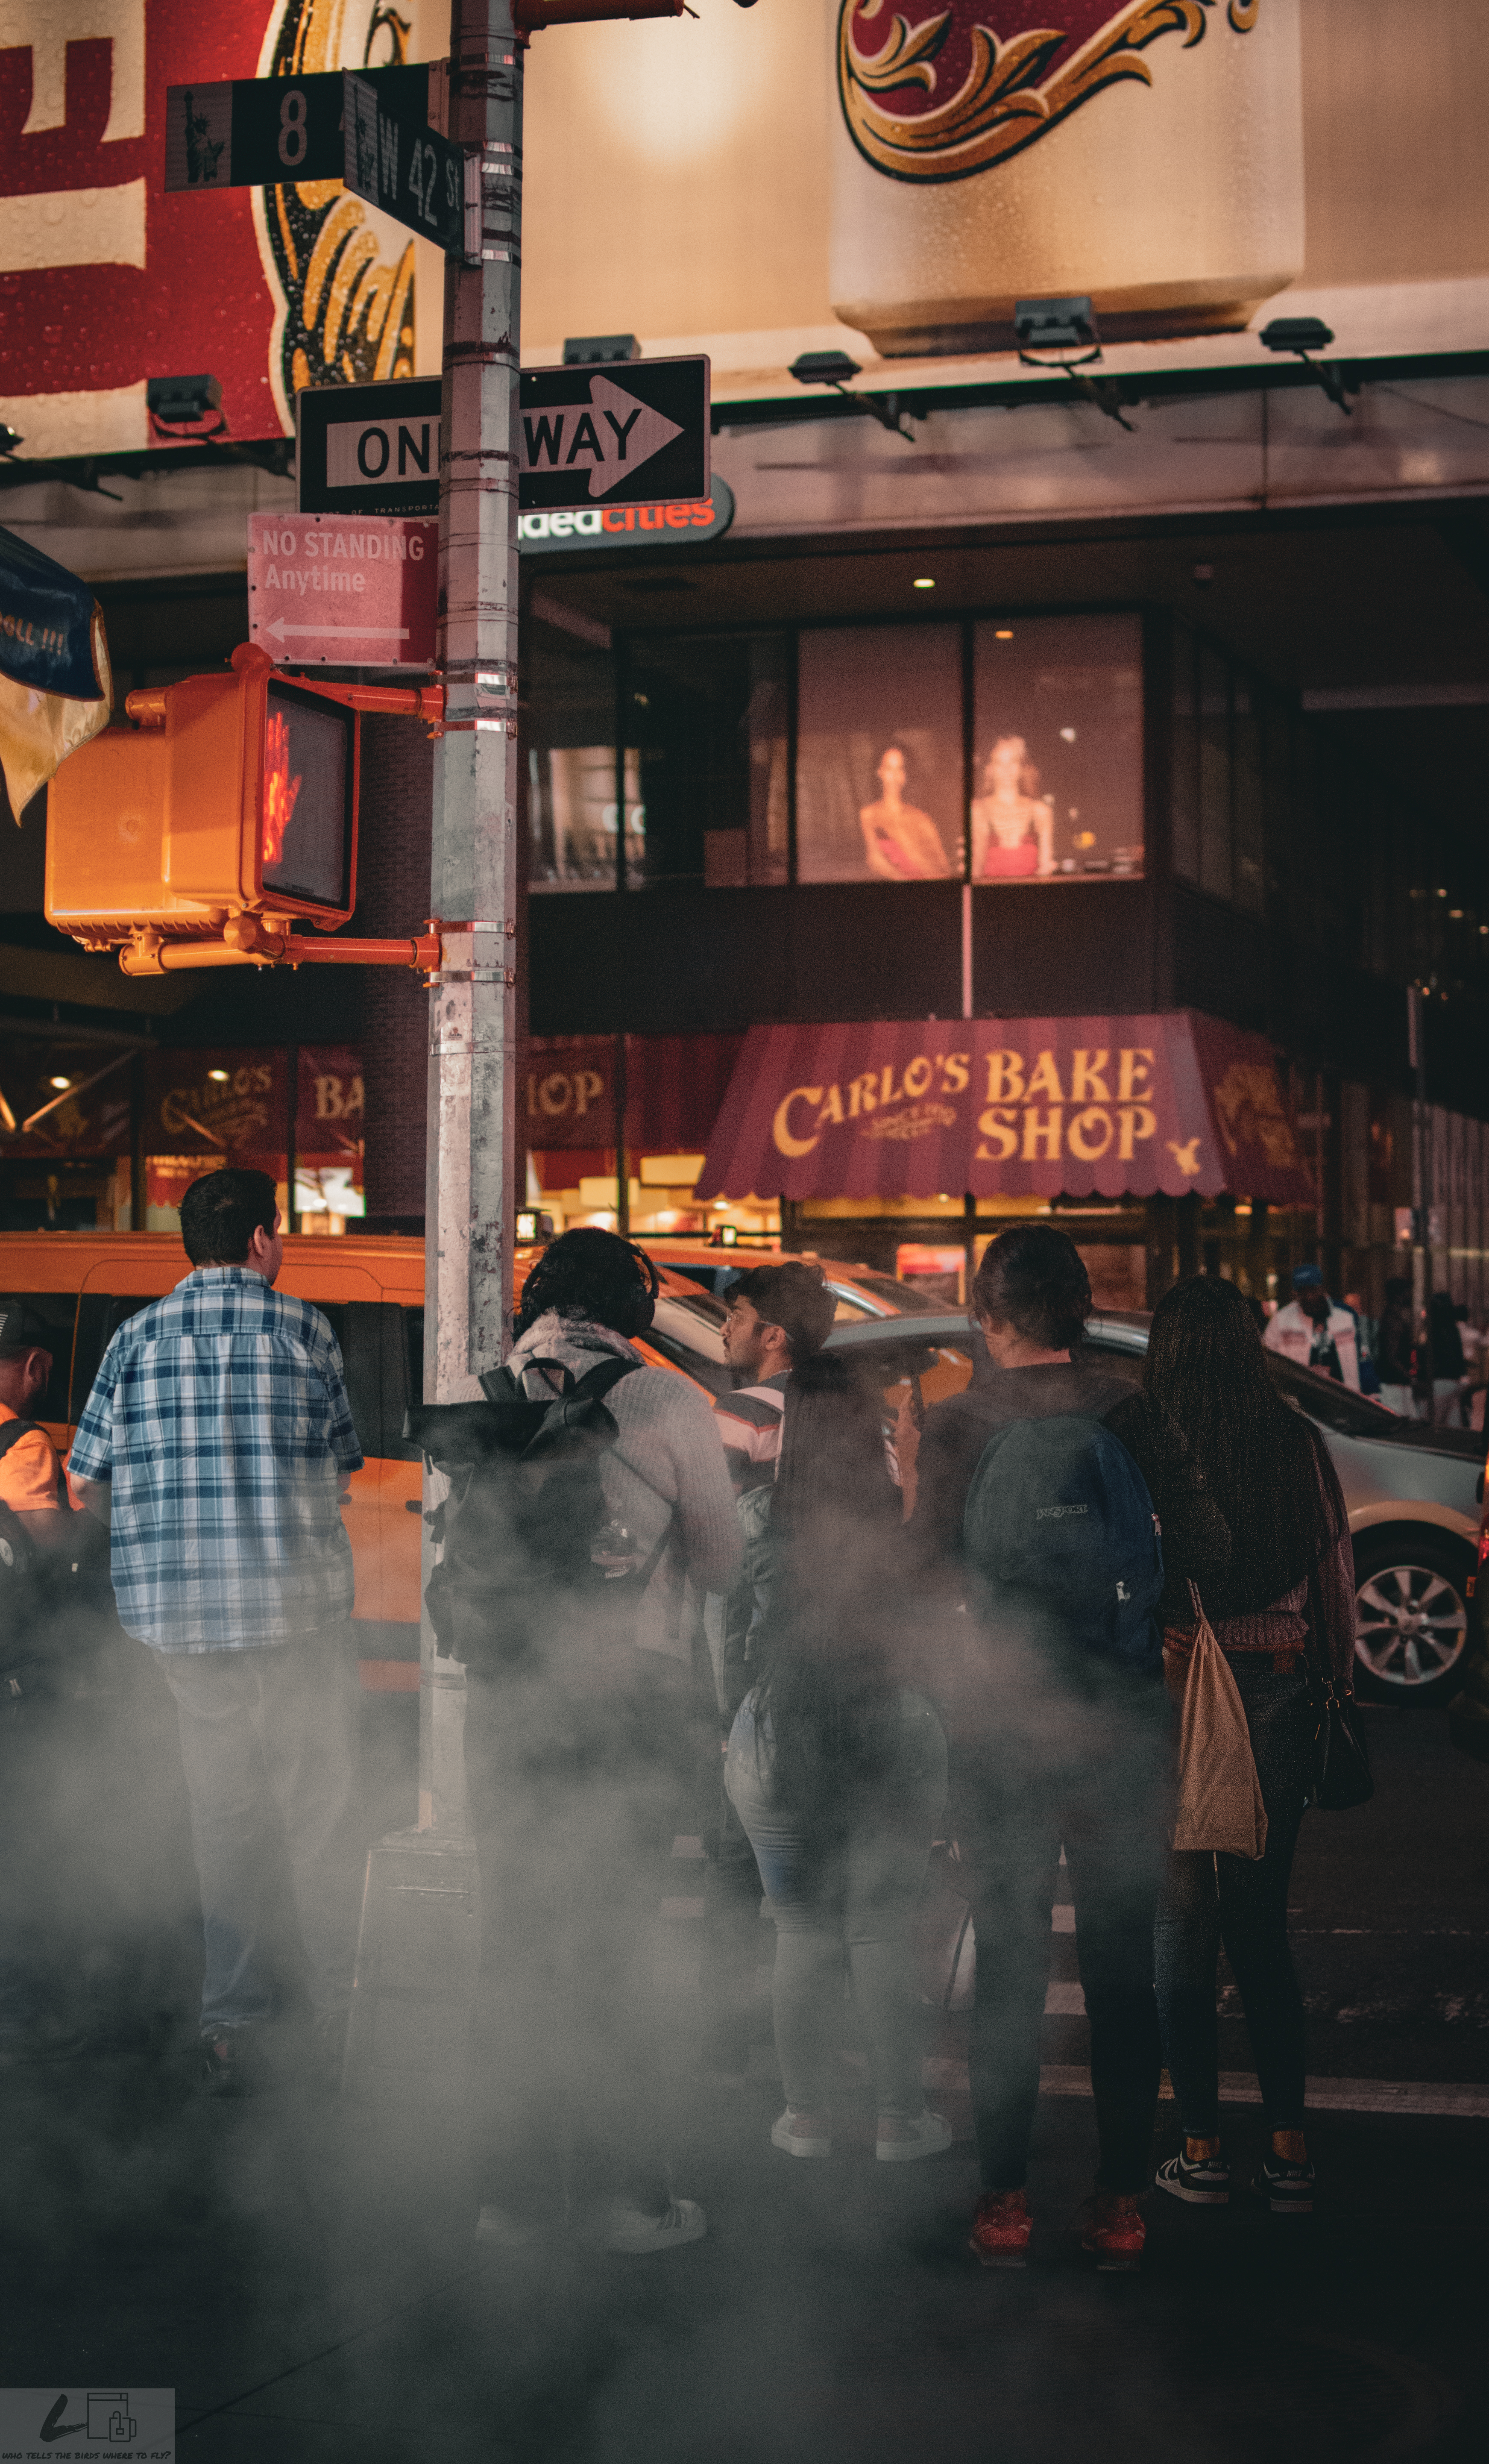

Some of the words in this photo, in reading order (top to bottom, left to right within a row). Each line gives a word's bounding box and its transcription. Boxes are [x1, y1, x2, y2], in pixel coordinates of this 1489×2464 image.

[278, 89, 308, 166] 8
[379, 112, 398, 200] W
[408, 138, 437, 227] 42
[446, 158, 460, 211] St
[357, 423, 440, 479] ON
[523, 408, 643, 468] WAY
[262, 530, 296, 556] NO
[305, 532, 424, 561] STANDING
[265, 564, 365, 596] Anytime
[528, 1070, 604, 1116] OP
[773, 1053, 970, 1158] CARLO'S
[985, 1048, 1154, 1103] BAKE
[974, 1106, 1157, 1161] SHOP
